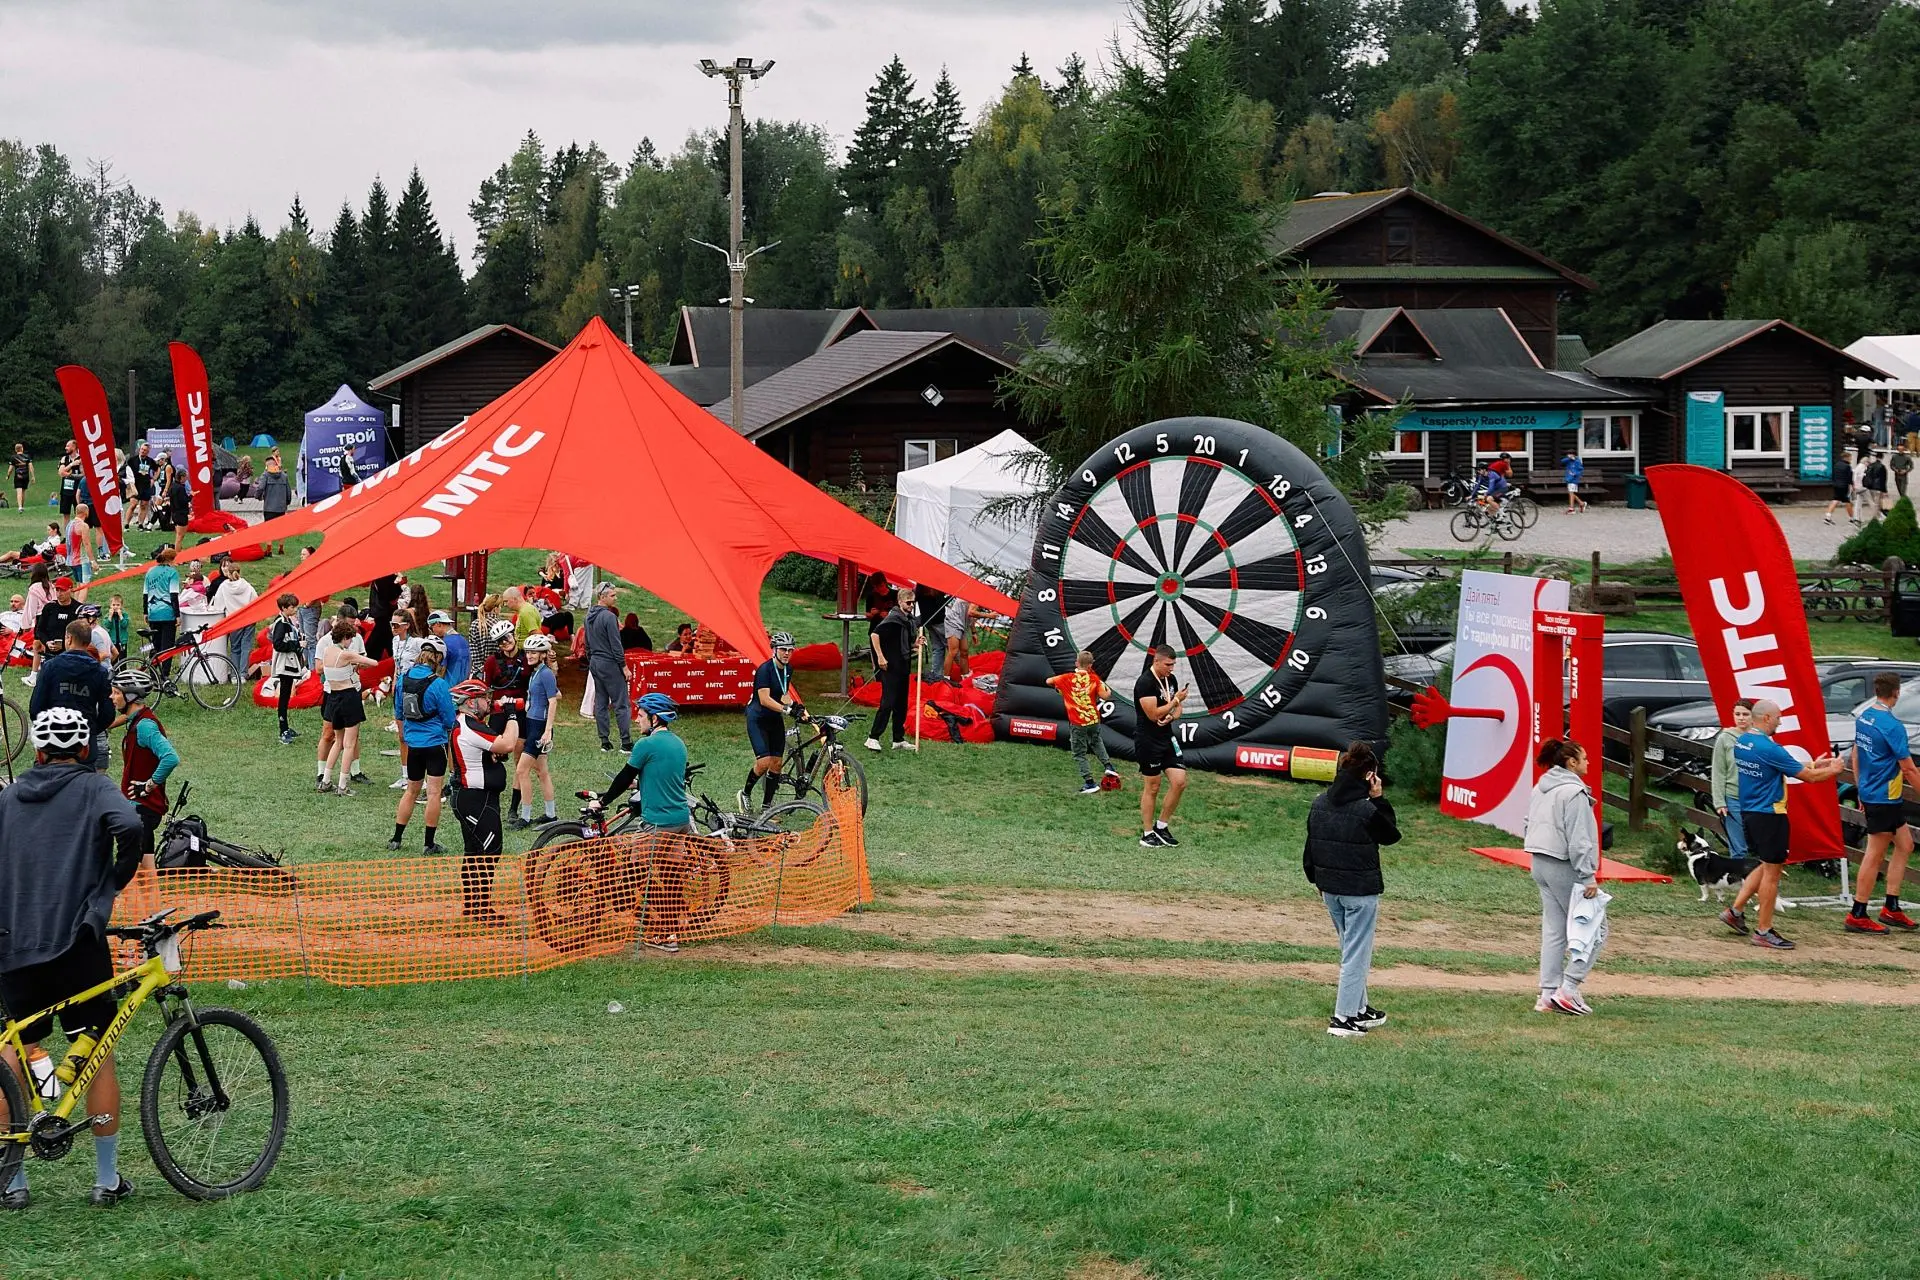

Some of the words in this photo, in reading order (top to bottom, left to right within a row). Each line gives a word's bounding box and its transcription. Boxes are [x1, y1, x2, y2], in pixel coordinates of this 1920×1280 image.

[188, 391, 208, 463] МТС
[1421, 416, 1479, 428] Kaspersky
[1481, 416, 1507, 425] Race
[1508, 415, 1537, 425] 2026
[336, 428, 376, 445] ТВОЙ
[1156, 433, 1169, 453] 5
[1193, 434, 1216, 456] 20
[82, 414, 116, 495] МТС
[319, 446, 346, 454] ОПЕРАТО
[1113, 442, 1135, 464] 12
[1238, 448, 1249, 467] 1
[312, 455, 344, 468] ТВО
[421, 424, 546, 517] МТС
[1081, 469, 1097, 487] 9
[1267, 474, 1291, 499] 18
[1056, 502, 1075, 521] 14
[1294, 514, 1313, 528] 4
[1041, 543, 1060, 560] 11
[1305, 553, 1328, 575] 13
[1037, 588, 1057, 602] 8
[1465, 587, 1480, 603] Дай
[1464, 605, 1475, 622] Ты
[1476, 611, 1490, 624] все
[1044, 627, 1064, 647] 16
[1463, 625, 1469, 641] С
[1471, 629, 1510, 649] тарифом
[1511, 633, 1531, 652] МТС
[1287, 649, 1310, 672] 10
[1709, 570, 1801, 734] МТС
[59, 682, 91, 698] FILA
[1259, 684, 1282, 709] 15
[1221, 710, 1240, 730] 2
[1178, 722, 1199, 743] 17
[1250, 752, 1284, 767] МТС
[1453, 785, 1477, 809] МТС
